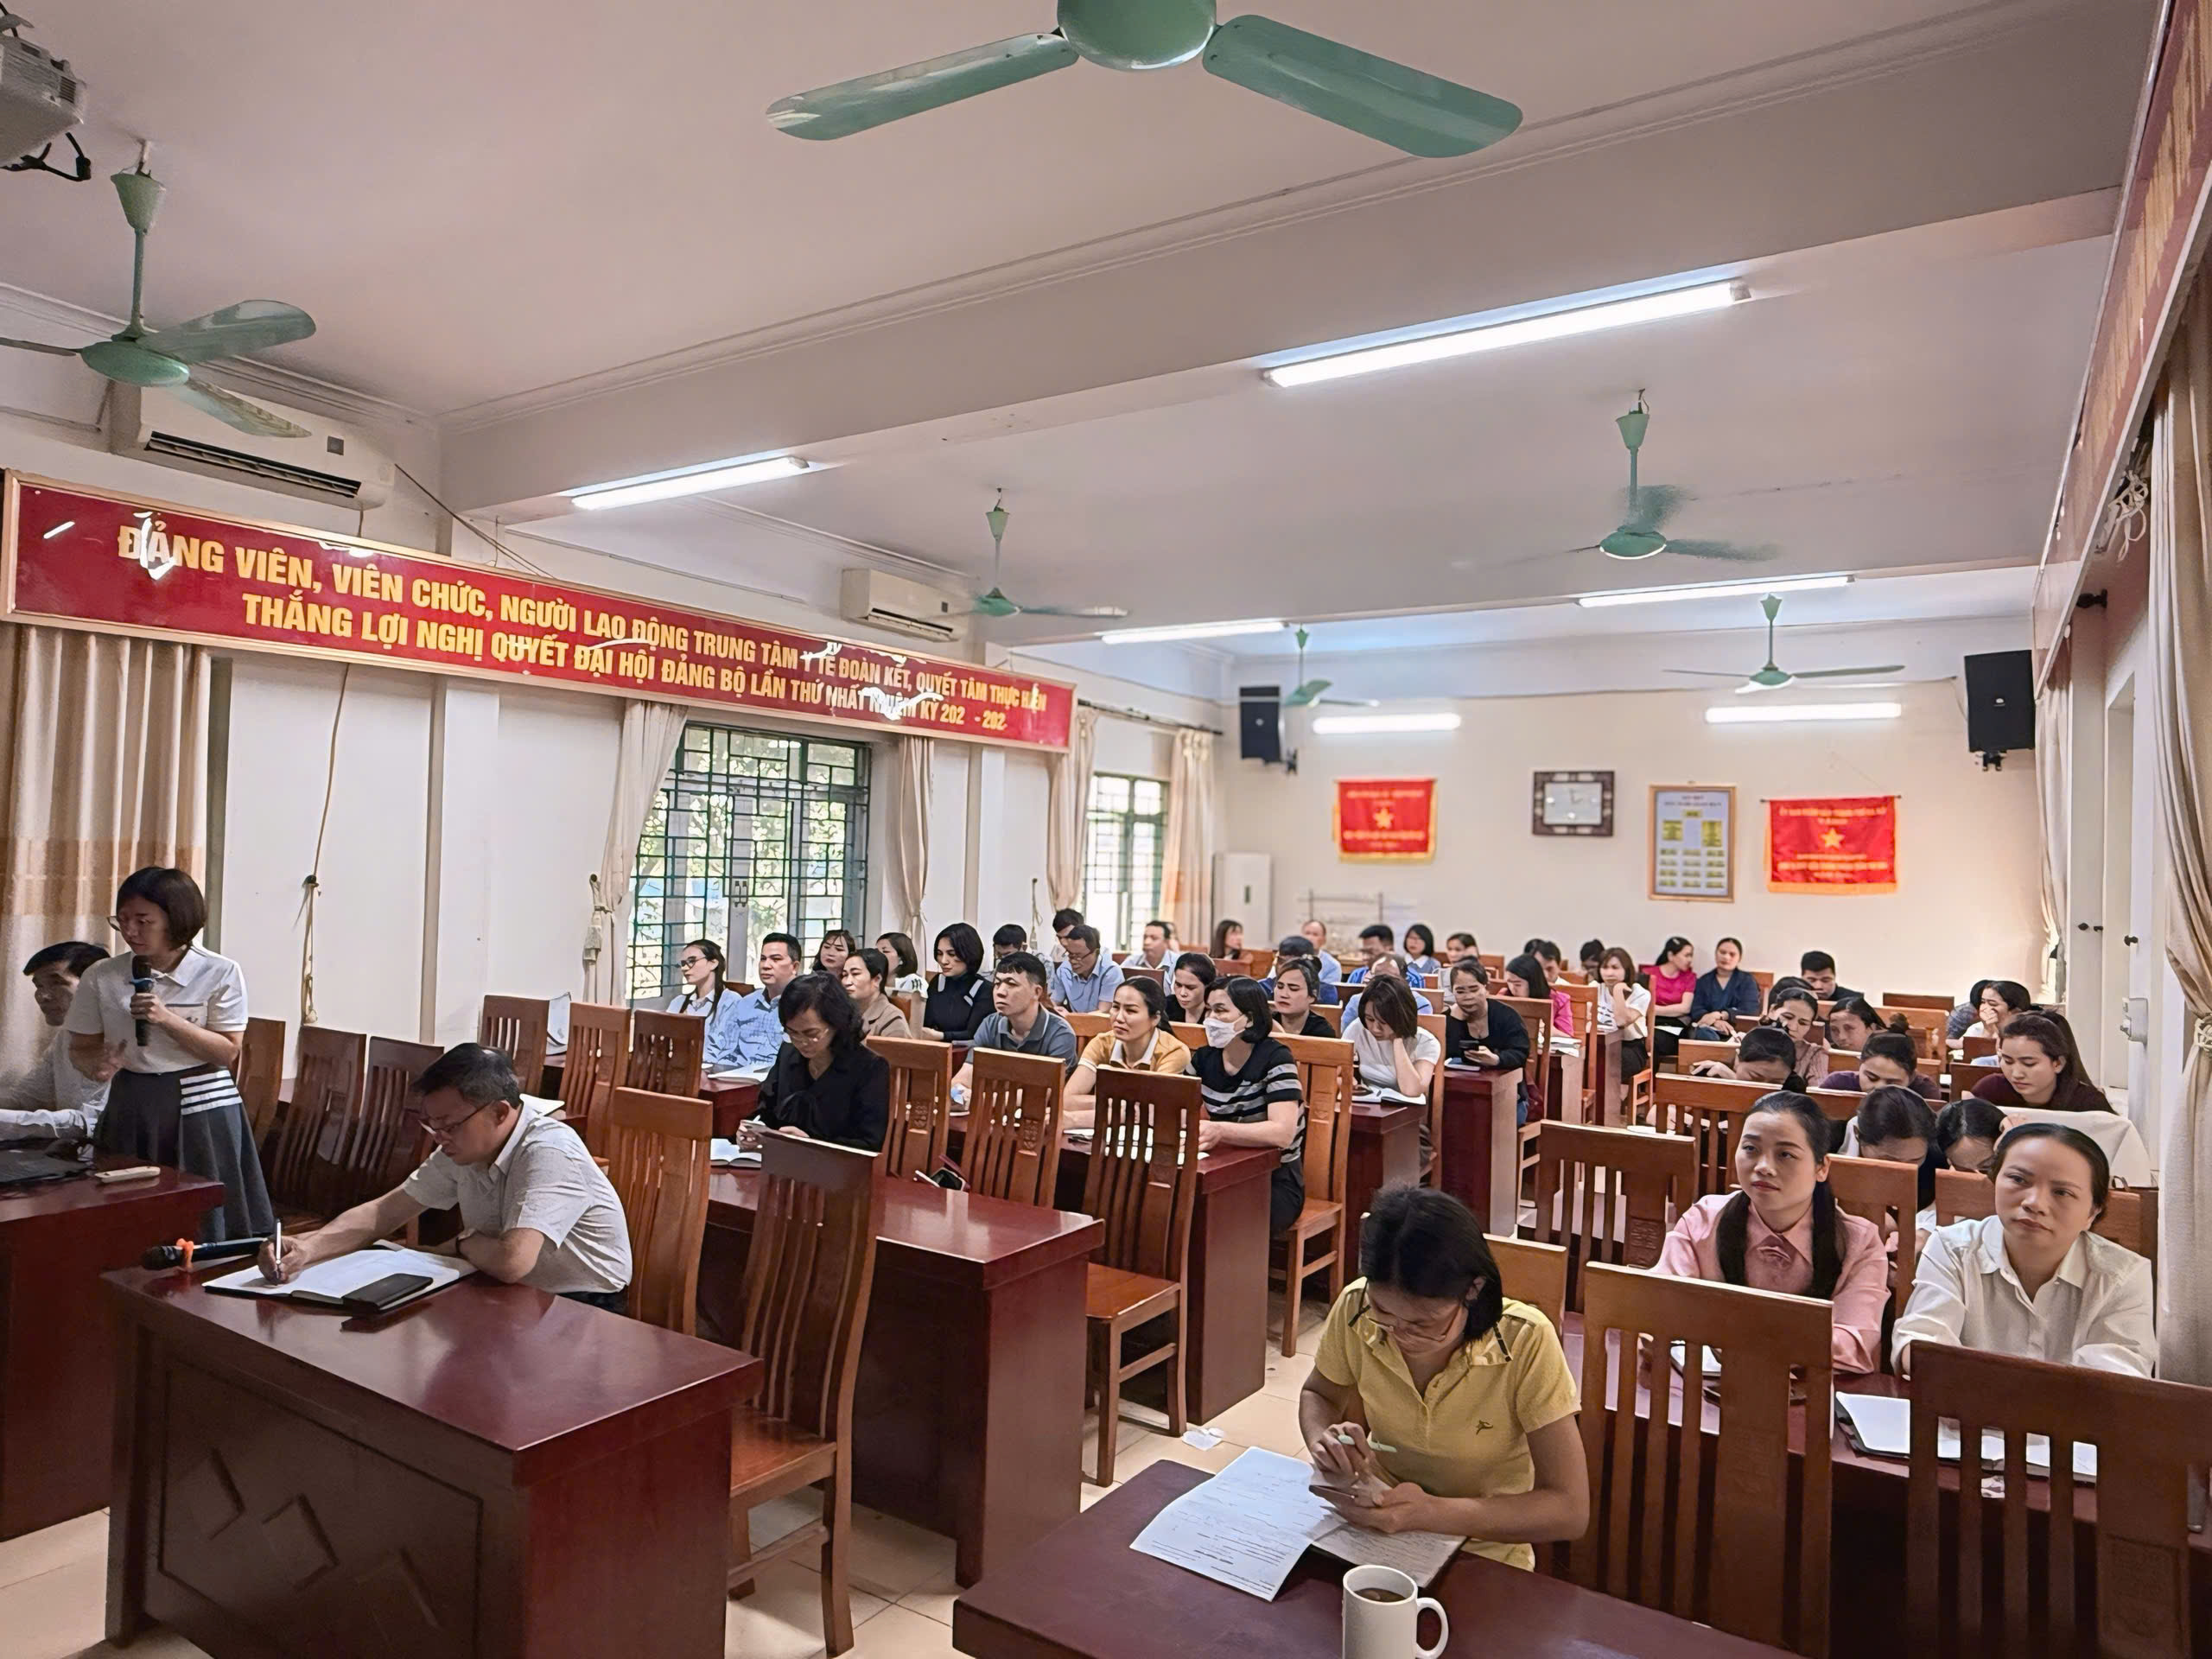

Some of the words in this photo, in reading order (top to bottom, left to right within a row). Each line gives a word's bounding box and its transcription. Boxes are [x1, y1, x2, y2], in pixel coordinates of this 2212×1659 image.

[117, 520, 226, 574] ĐẢNG
[235, 546, 321, 594] VIÊN,
[332, 563, 403, 603] VIÊN
[411, 578, 493, 622] CHỨC,
[500, 594, 576, 632] NGƯỜI
[583, 610, 626, 640] LAO
[632, 616, 689, 652] ĐỘNG
[694, 630, 756, 663] TRUNG
[760, 639, 798, 670] TÂM
[838, 657, 880, 684] ĐOÀN
[916, 671, 957, 696] QUYẾT
[960, 677, 988, 702] TÂM
[988, 684, 1020, 710] THỰC
[242, 589, 353, 638] THẮNG
[361, 611, 409, 650] LỢI
[416, 620, 483, 661] NGHỊ
[491, 632, 569, 667] QUYẾT
[574, 645, 613, 677] ĐẠI
[619, 649, 655, 684] HỘI
[661, 653, 715, 690] ĐẢNG
[720, 666, 746, 698] BỘ
[750, 668, 786, 699] LẦN
[790, 678, 825, 704] THỨ
[940, 704, 966, 726] 202
